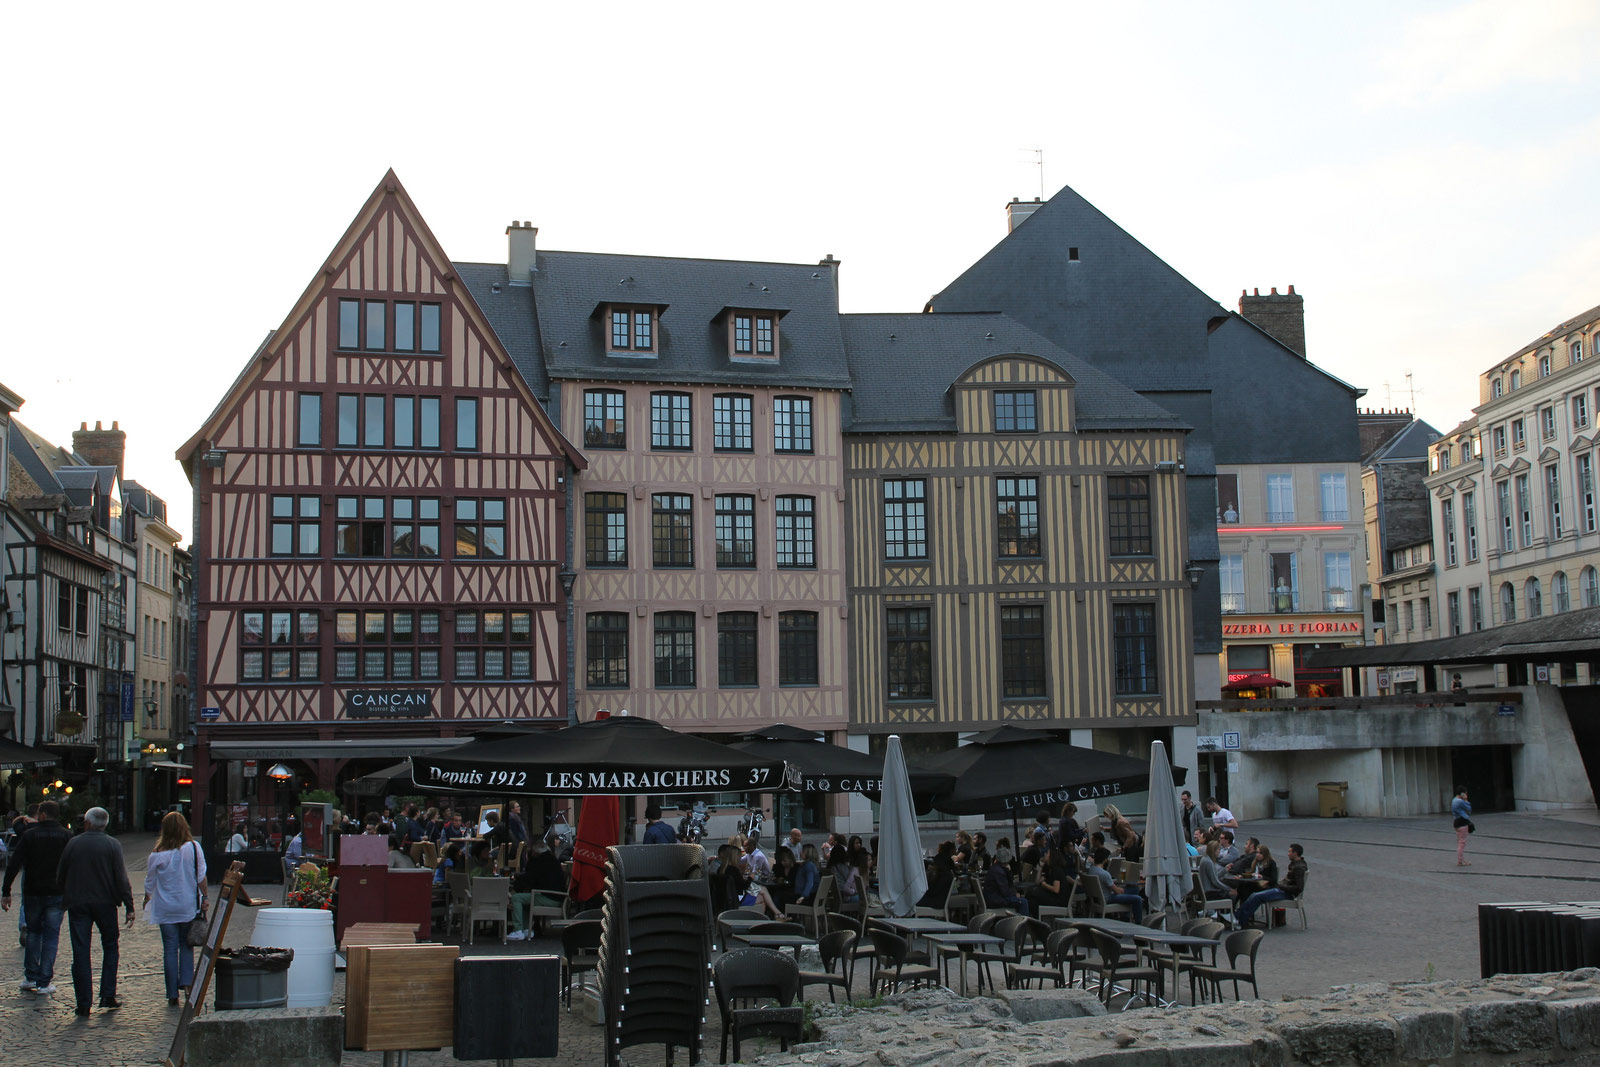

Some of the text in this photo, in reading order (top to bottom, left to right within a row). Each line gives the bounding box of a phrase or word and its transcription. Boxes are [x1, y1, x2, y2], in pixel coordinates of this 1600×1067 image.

[1223, 621, 1359, 635] ZZERIA LE FLORIAN
[352, 693, 426, 706] CANCAN
[246, 750, 293, 758] CANCAN
[430, 766, 482, 786] Depuis
[486, 770, 527, 787] 1912
[545, 771, 583, 789] LES
[588, 768, 731, 788] MARAICHERS
[749, 768, 770, 784] 37
[1078, 783, 1122, 799] CAFE
